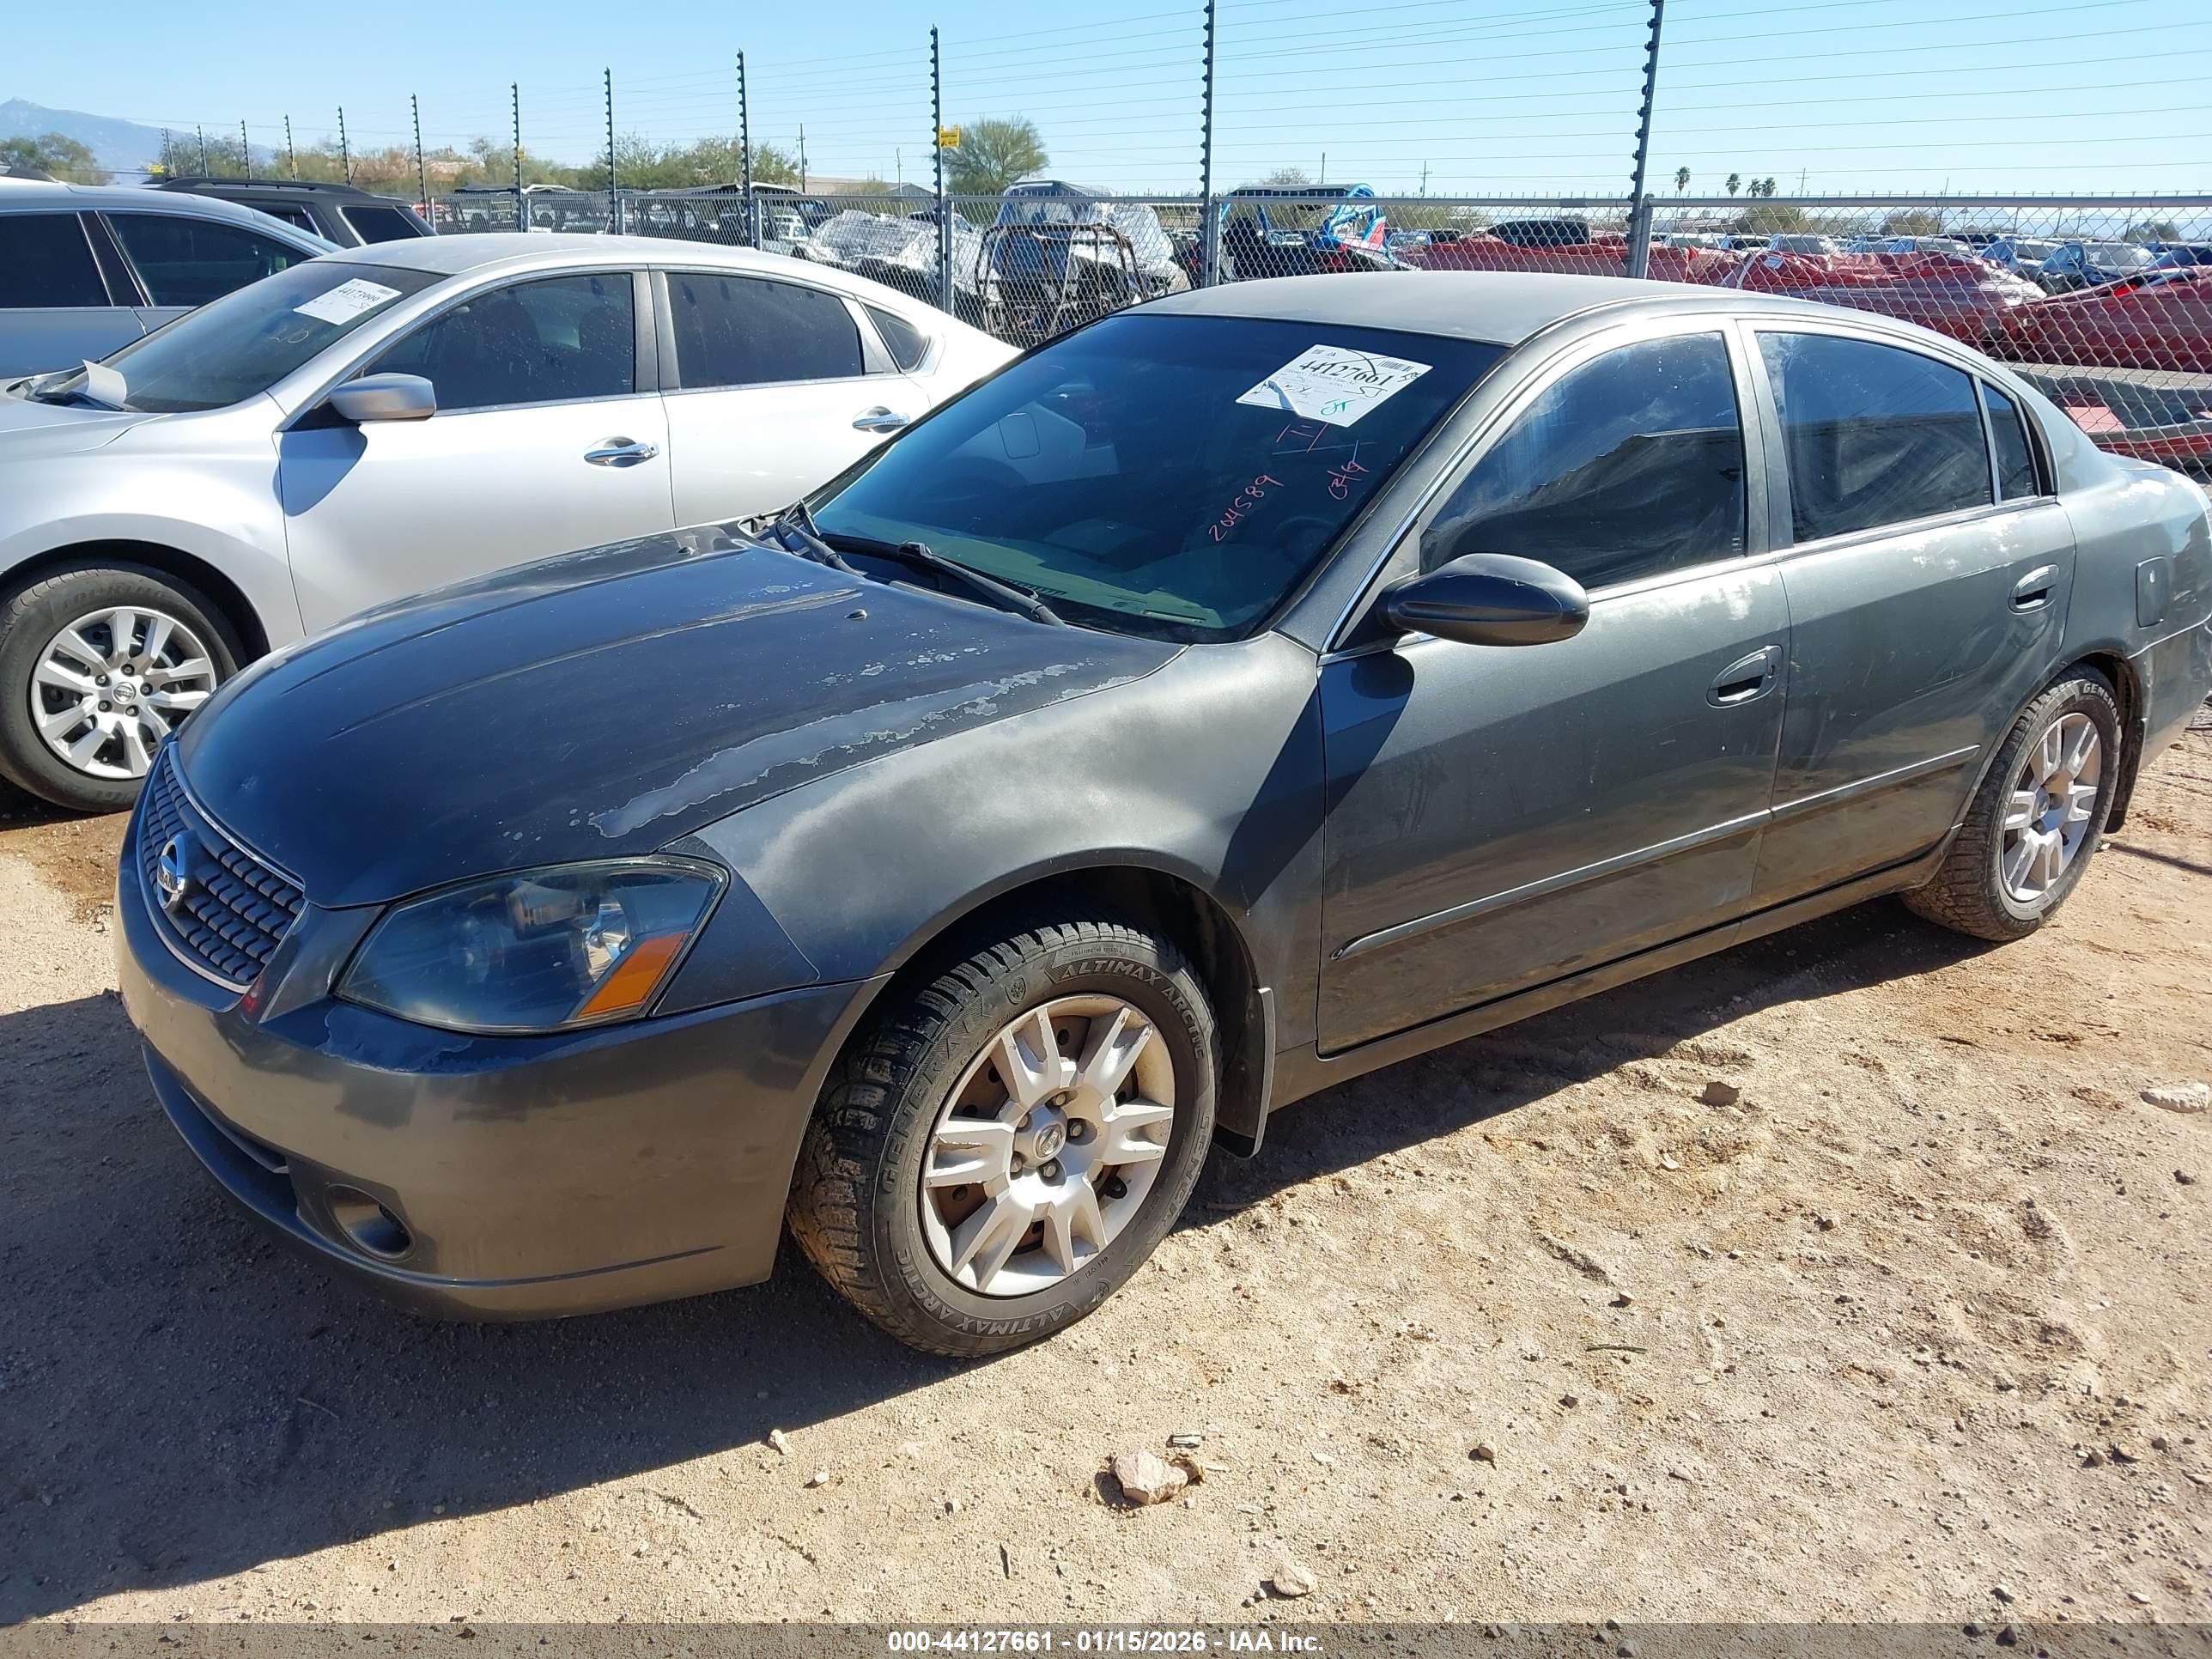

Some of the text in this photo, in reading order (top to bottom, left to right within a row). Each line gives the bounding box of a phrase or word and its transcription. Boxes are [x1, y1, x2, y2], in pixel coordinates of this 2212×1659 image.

[1298, 360, 1395, 386] 44127661
[1208, 474, 1285, 543] 204589
[1060, 959, 1205, 1060] ALTIMAX ARCTIC
[896, 1248, 1066, 1335] ALTIMAX ARCTIC
